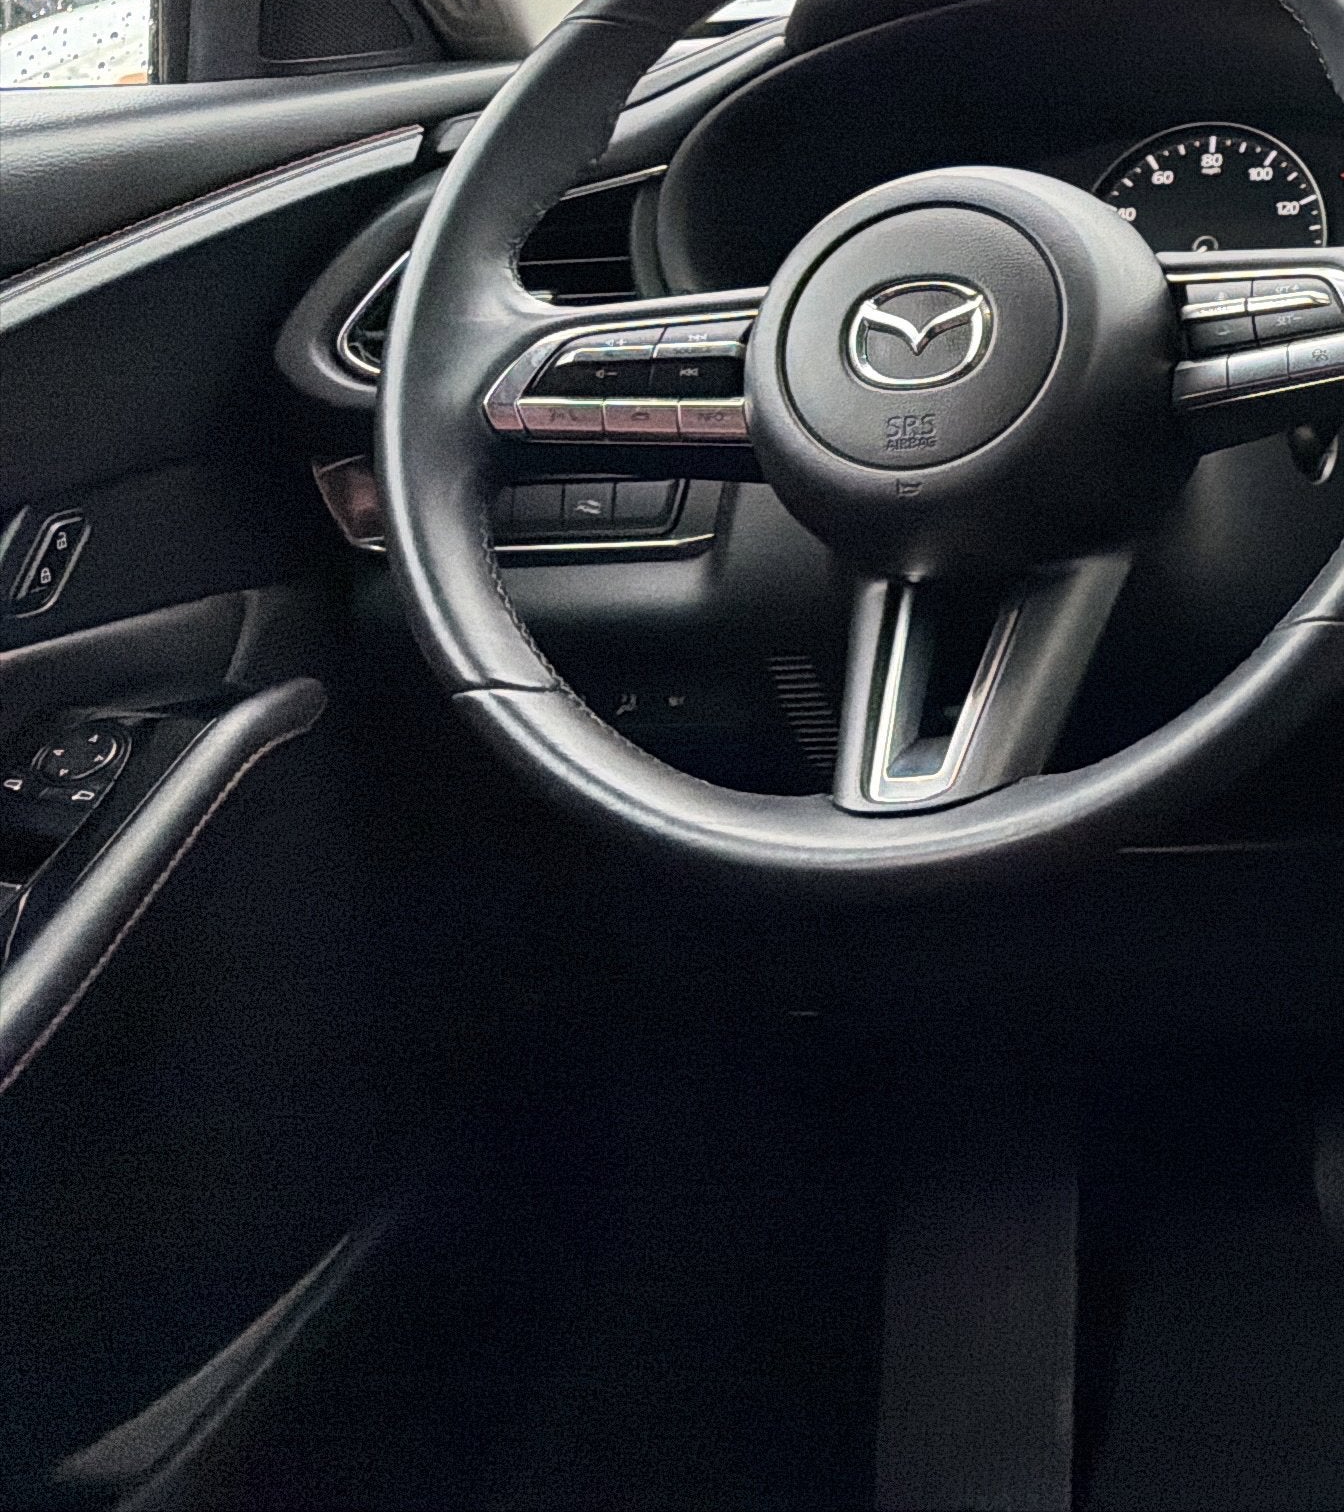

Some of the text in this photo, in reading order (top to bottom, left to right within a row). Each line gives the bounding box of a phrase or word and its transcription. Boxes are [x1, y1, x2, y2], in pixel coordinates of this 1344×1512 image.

[1201, 153, 1223, 167] 80
[1151, 170, 1174, 185] 60
[1249, 167, 1273, 181] 100
[1276, 201, 1300, 215] 120
[886, 413, 936, 437] SRS
